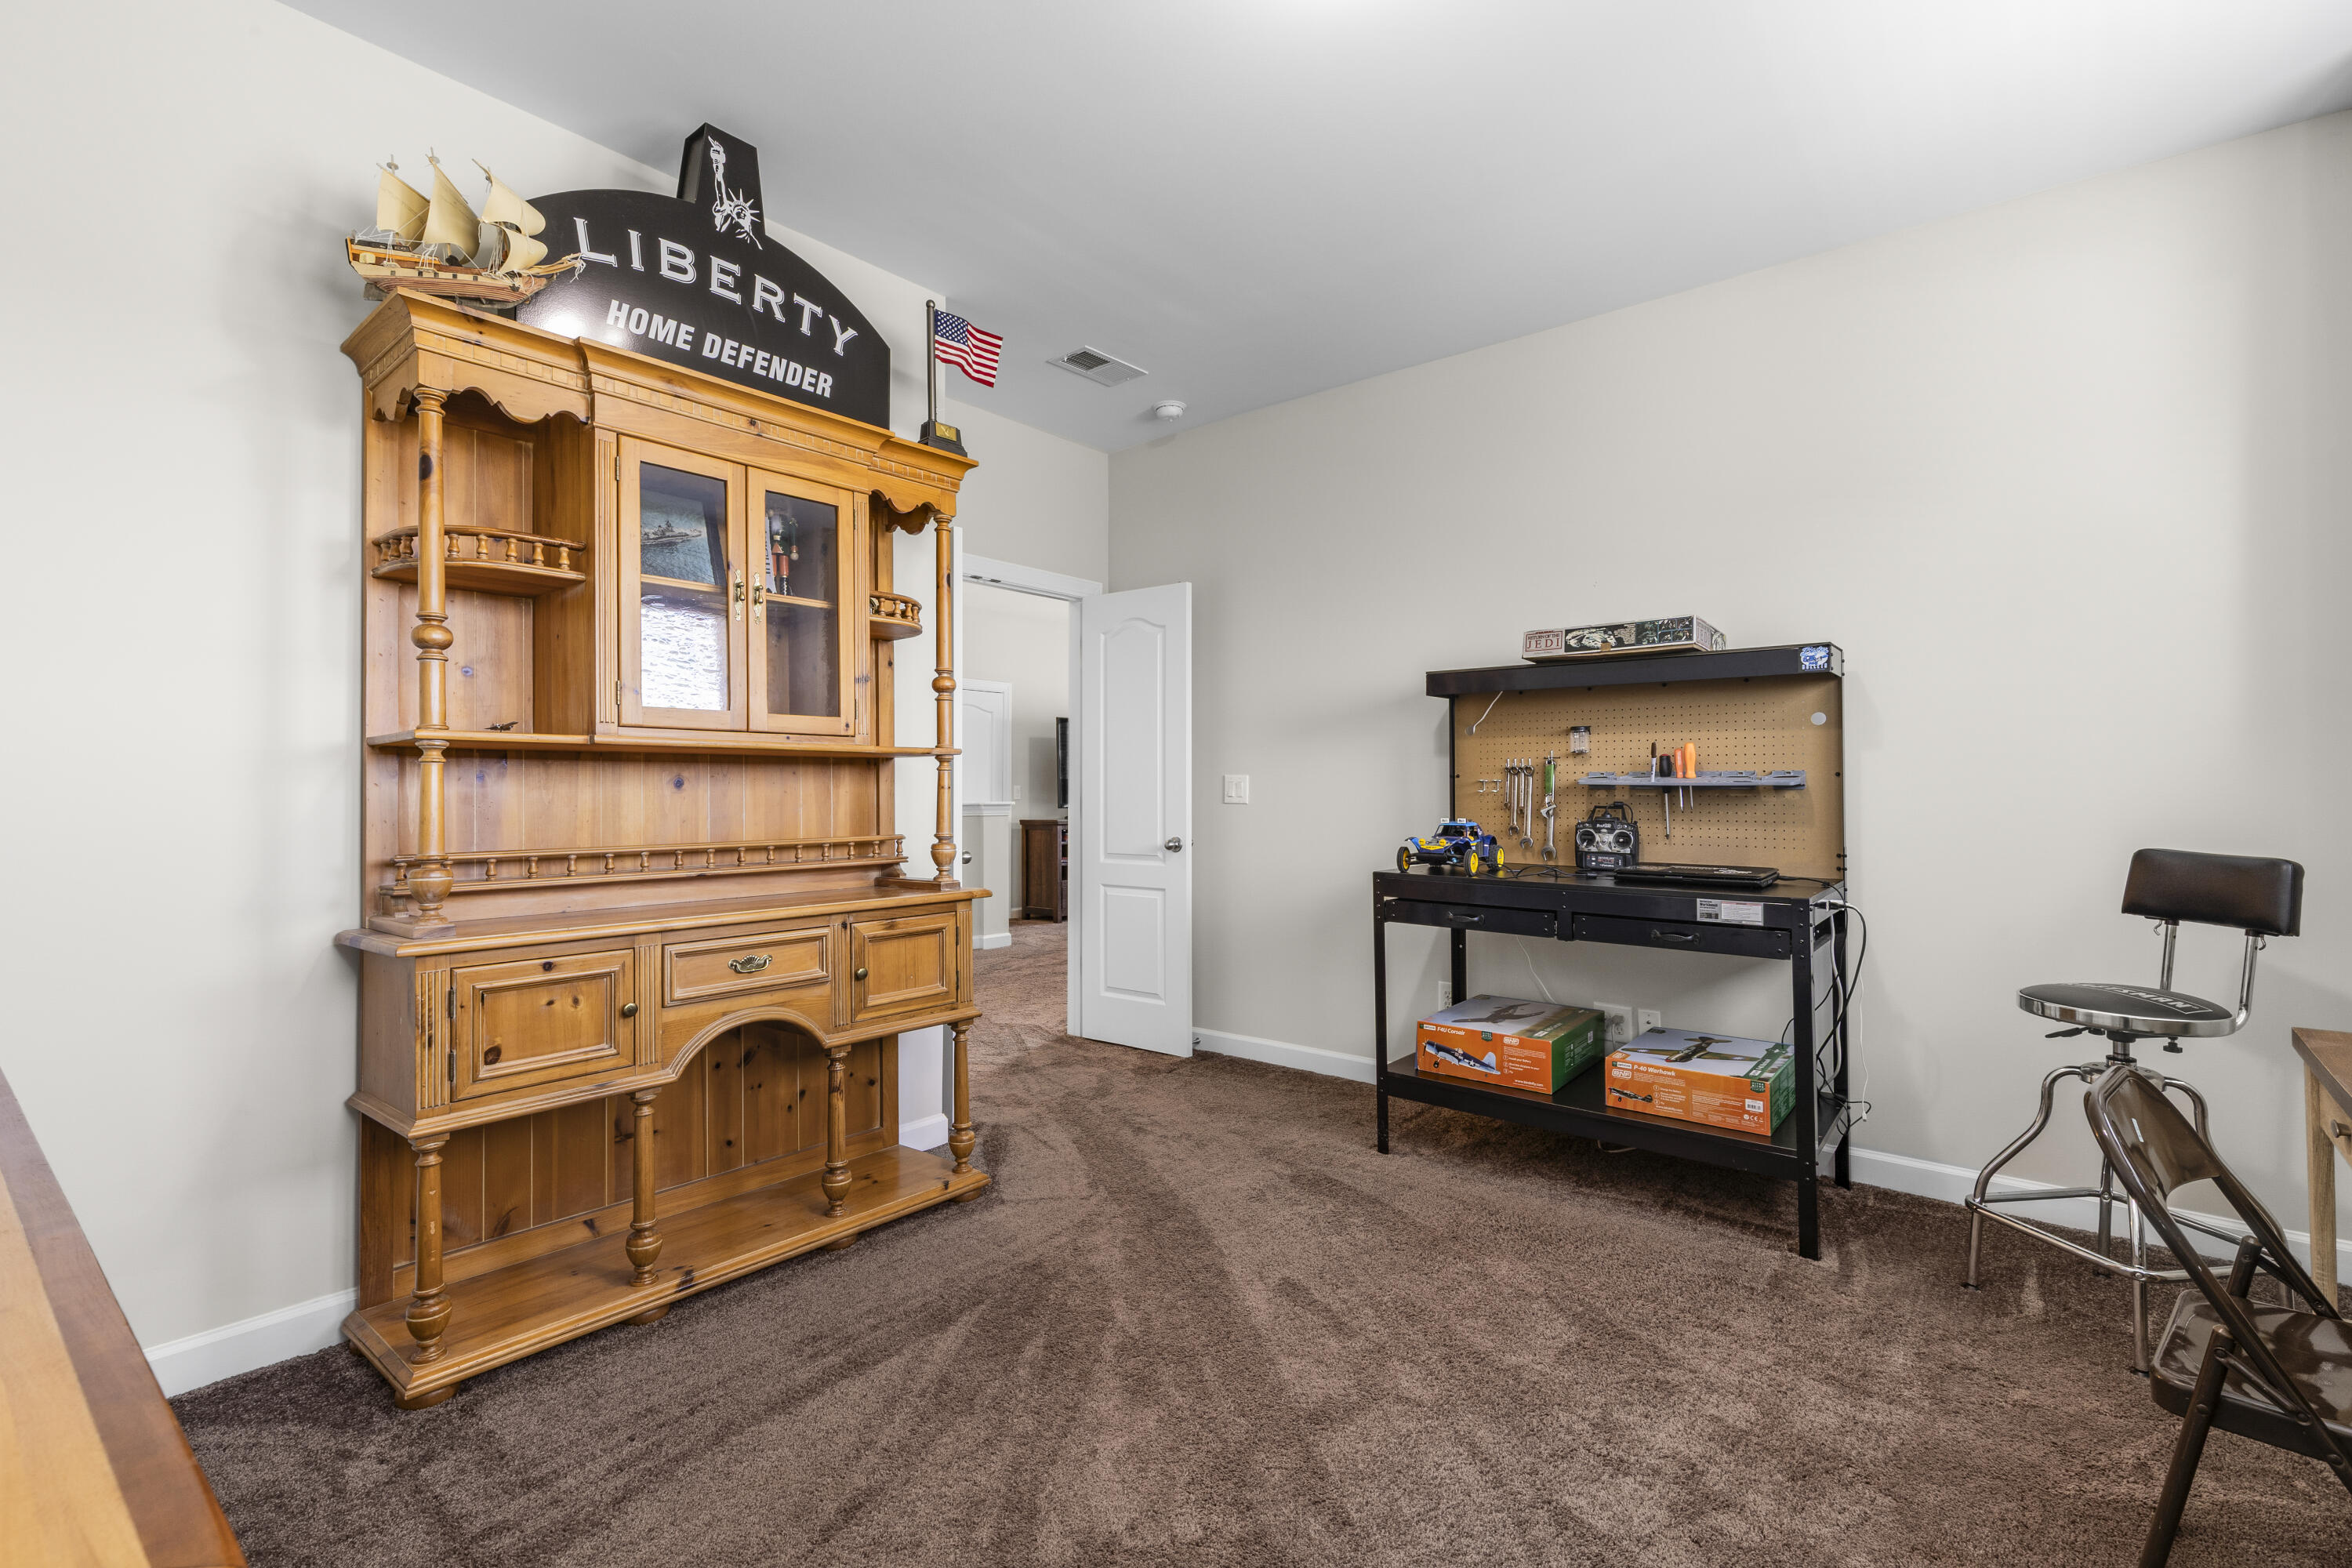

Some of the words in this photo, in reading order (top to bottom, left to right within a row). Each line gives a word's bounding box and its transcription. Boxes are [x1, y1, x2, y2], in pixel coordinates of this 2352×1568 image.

[573, 216, 858, 357] LIBERTY
[606, 299, 695, 352] HOME
[702, 332, 833, 398] DEFENDER
[1527, 638, 1559, 649] JEDI
[2062, 983, 2193, 1008] AFTSMAN
[1648, 1067, 1675, 1076] Warhawk
